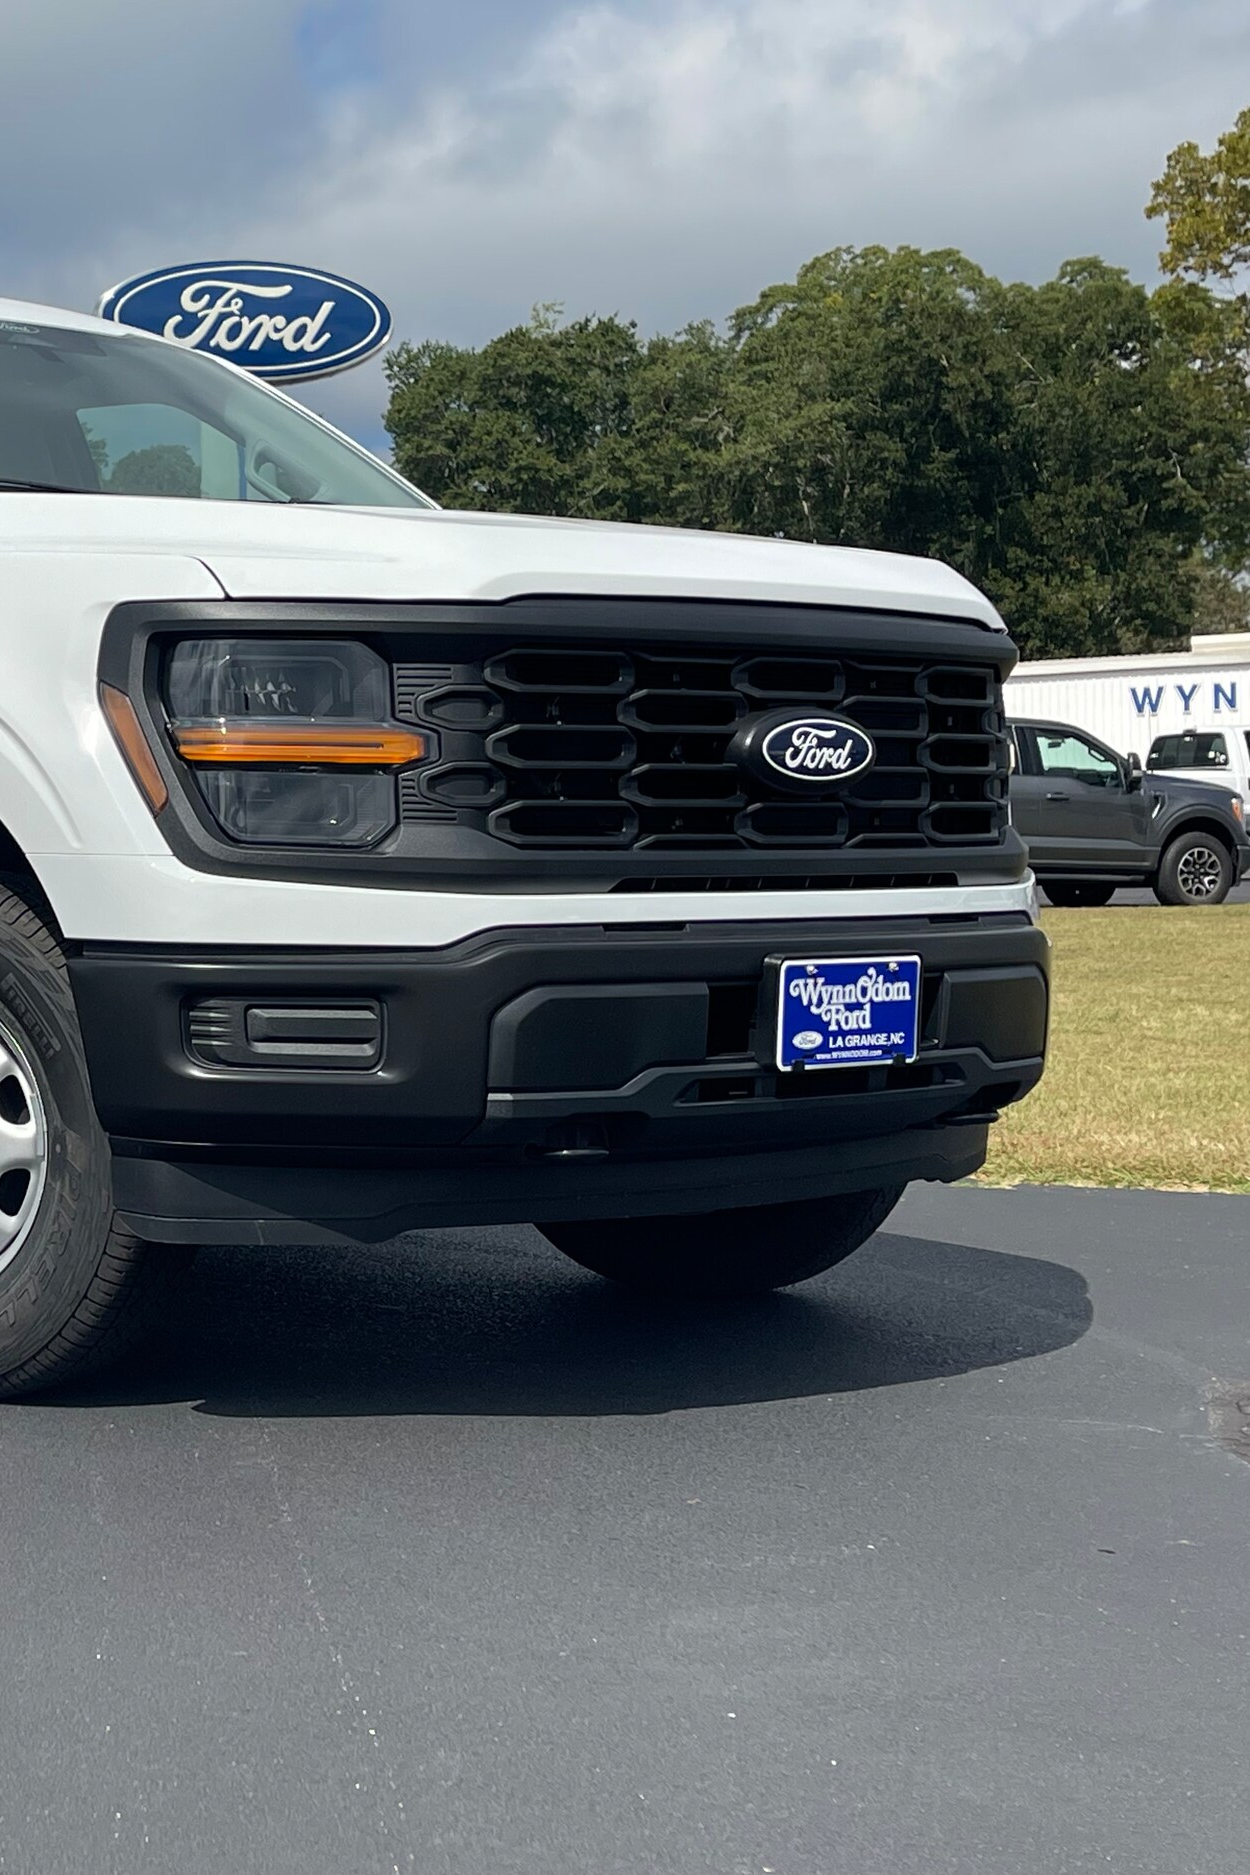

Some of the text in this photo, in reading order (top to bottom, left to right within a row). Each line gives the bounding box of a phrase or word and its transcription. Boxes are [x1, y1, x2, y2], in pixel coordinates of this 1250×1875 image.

[163, 280, 336, 352] Ford
[1130, 682, 1237, 715] WYN
[785, 726, 853, 769] Ford
[0, 972, 61, 1059] PIRELLI
[821, 1003, 872, 1032] Ford
